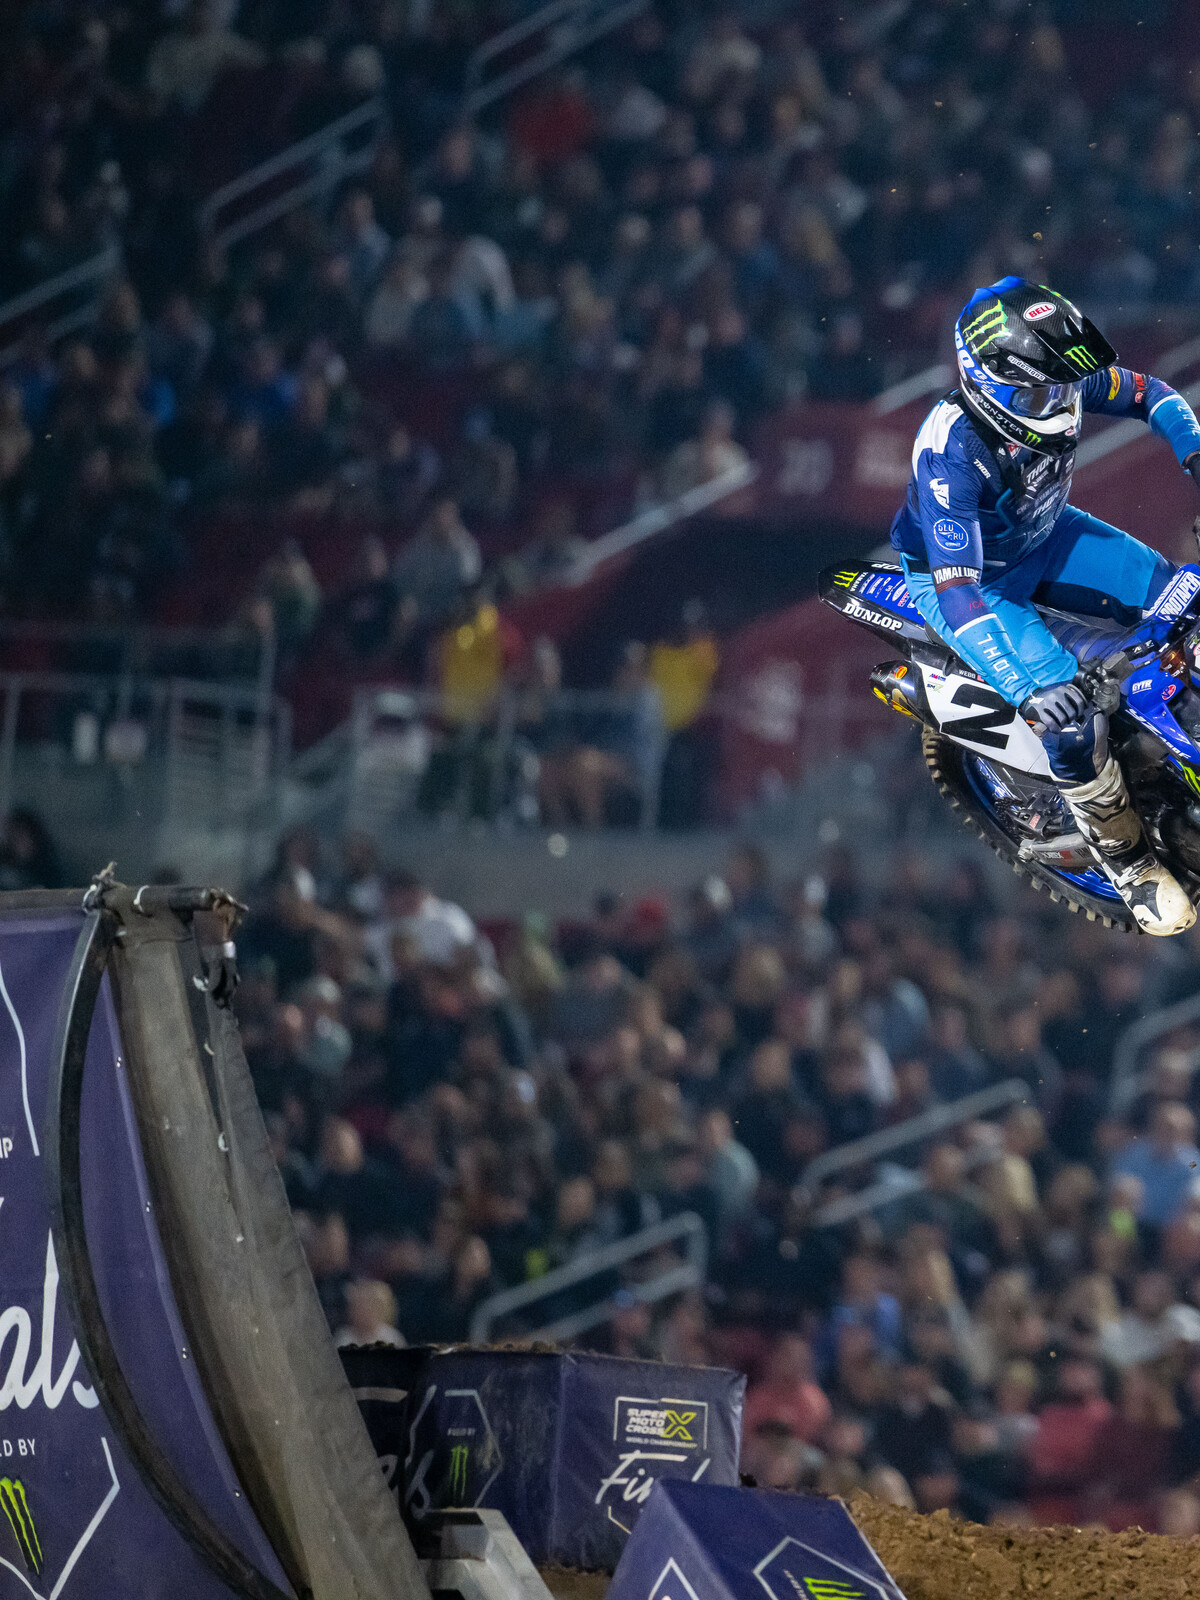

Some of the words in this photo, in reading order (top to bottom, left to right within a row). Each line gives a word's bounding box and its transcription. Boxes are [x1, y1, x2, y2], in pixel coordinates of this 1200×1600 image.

[1029, 305, 1052, 318] BELL
[977, 394, 1024, 435] MONSTER
[973, 458, 991, 479] THOR
[1160, 573, 1200, 620] PROTAPER
[841, 602, 903, 631] DUNLOP
[1132, 679, 1153, 692] GYTR
[941, 683, 1018, 750] 2
[629, 1416, 665, 1427] MOTO
[18, 1438, 36, 1456] BY
